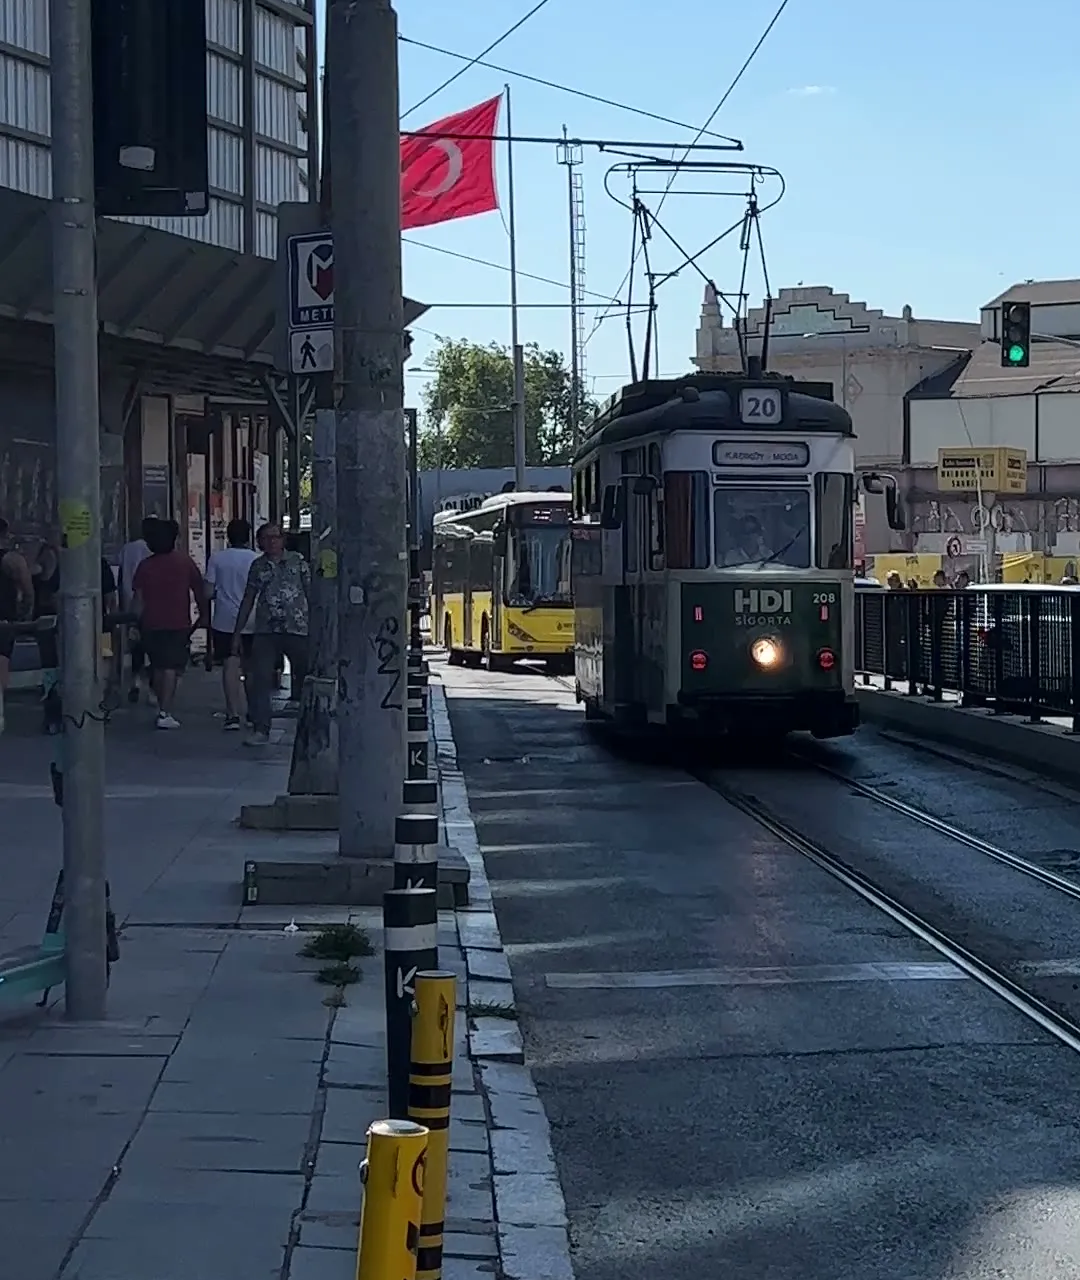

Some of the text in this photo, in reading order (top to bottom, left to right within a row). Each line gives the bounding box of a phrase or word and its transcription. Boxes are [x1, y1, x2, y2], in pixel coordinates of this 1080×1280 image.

[747, 397, 776, 417] 20
[734, 589, 792, 613] HDI
[812, 593, 836, 604] 208
[735, 614, 792, 626] SİGORTA
[411, 749, 425, 767] K
